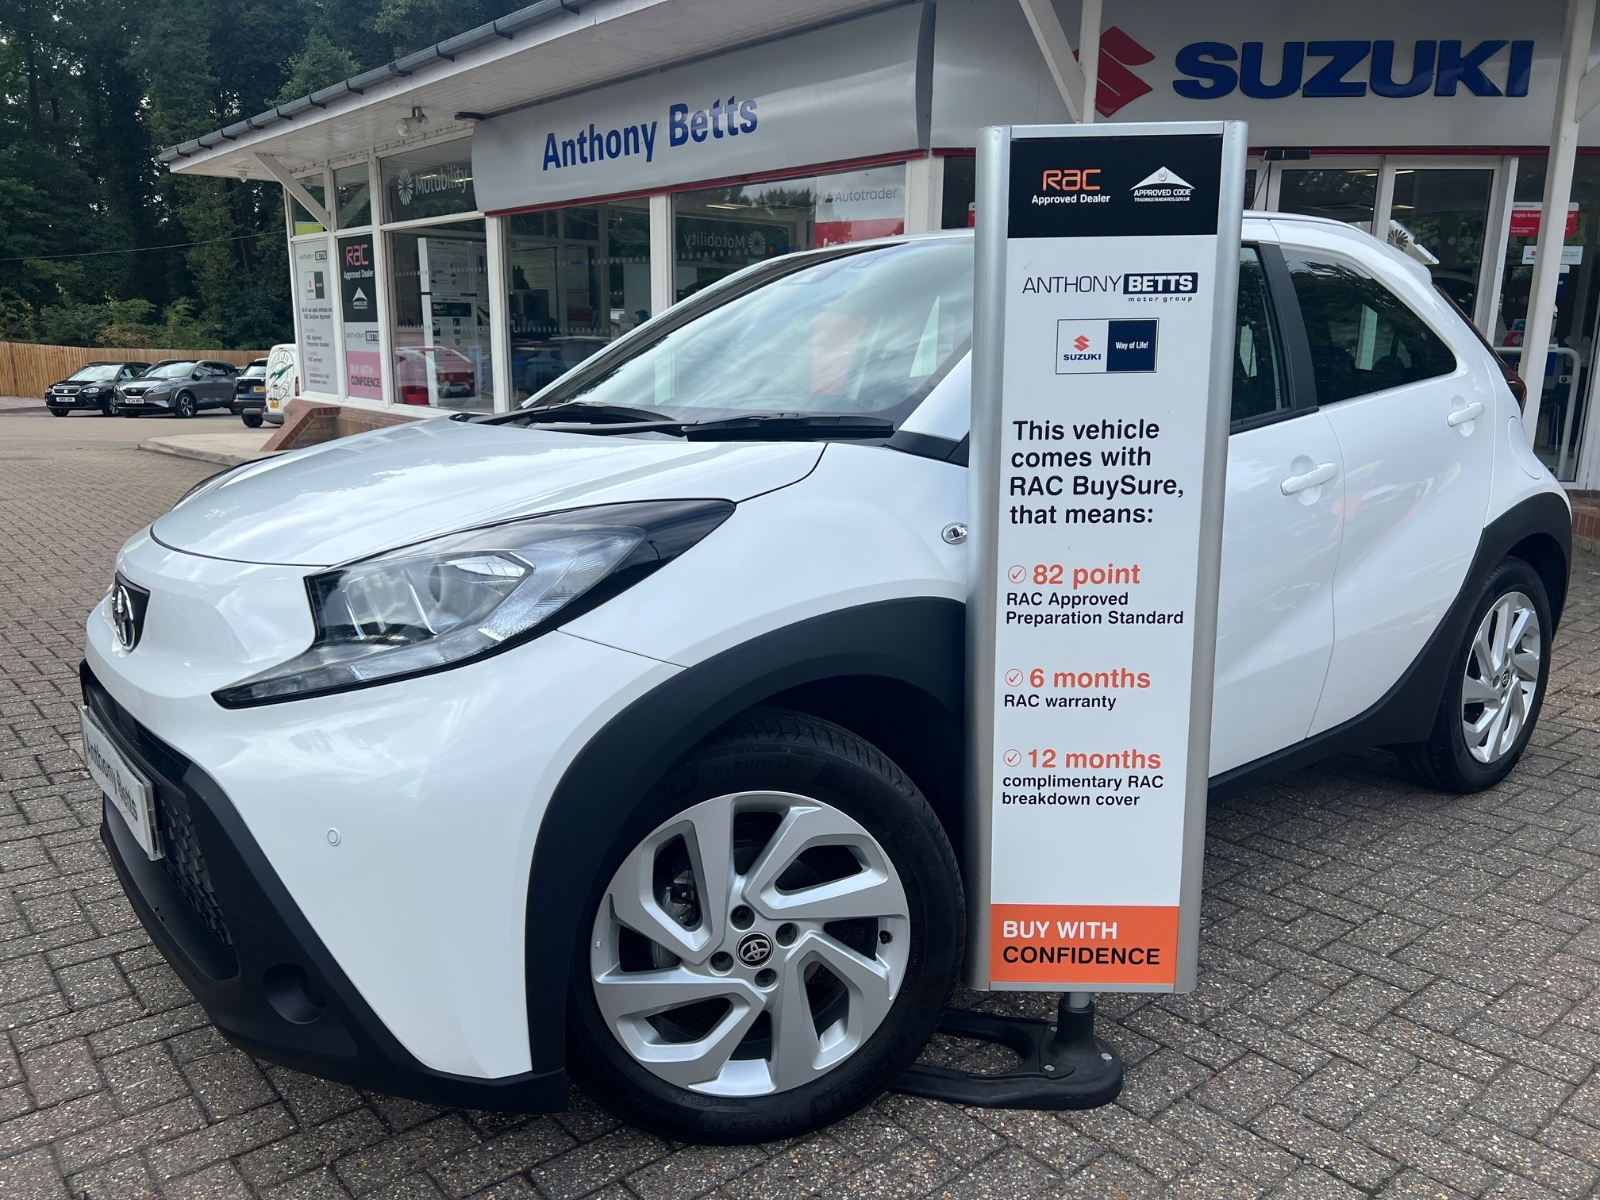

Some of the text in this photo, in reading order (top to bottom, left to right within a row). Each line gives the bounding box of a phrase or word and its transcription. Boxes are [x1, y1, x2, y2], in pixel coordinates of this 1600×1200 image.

[1172, 39, 1534, 99] SUZUKI
[543, 95, 758, 171] Anthony Betts
[835, 188, 898, 202] Autotrader
[1032, 193, 1110, 206] Approved Dealer
[1173, 188, 1191, 196] CODE
[1022, 275, 1193, 294] ANTHONY BETTS
[1116, 342, 1128, 350] Way
[1136, 341, 1149, 349] Life!
[1063, 353, 1102, 361] SUZUKI
[1013, 418, 1160, 441] This vehicle
[1011, 446, 1152, 468] comes with
[1010, 474, 1184, 500] RAC BuySure,
[1010, 505, 1154, 524] that means:
[1032, 563, 1141, 590] 82 point
[1006, 592, 1129, 609] RAC Approved
[1006, 610, 1184, 627] Preparation Standard
[1029, 667, 1151, 689] 6 months
[1004, 694, 1117, 711] RAC warranty
[1028, 749, 1162, 769] 12 months
[1002, 775, 1164, 791] complimentary RAC
[1002, 792, 1140, 806] breakdown cover
[1003, 920, 1118, 940] BUY WITH
[1002, 946, 1161, 965] CONFIDENCE
